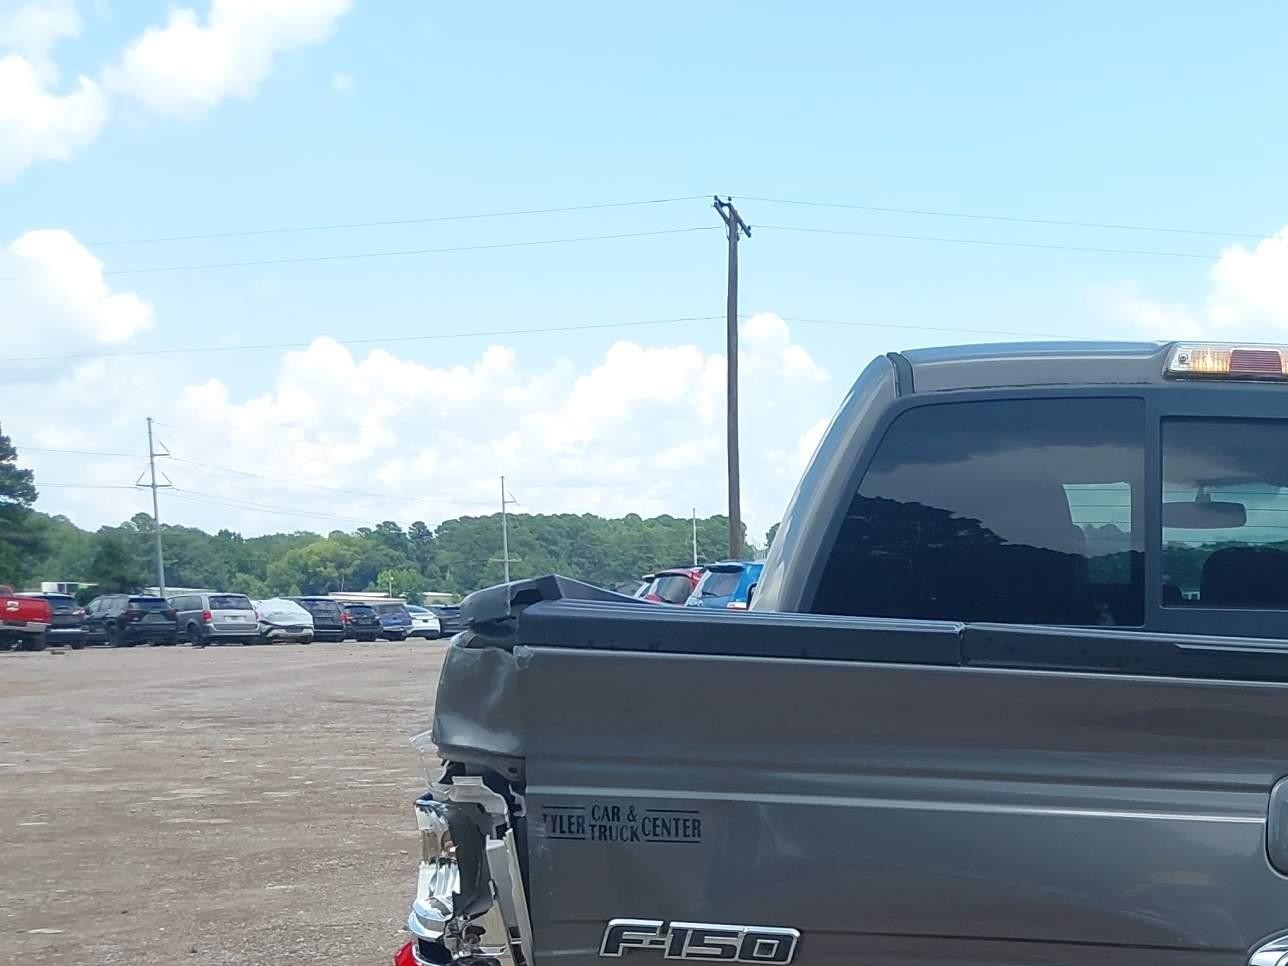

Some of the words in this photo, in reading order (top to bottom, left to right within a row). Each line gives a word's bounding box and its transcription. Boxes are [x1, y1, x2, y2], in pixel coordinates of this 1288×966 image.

[591, 804, 620, 822] CAR
[627, 805, 638, 822] &
[589, 824, 640, 842] TRUCK
[641, 816, 701, 838] CENTER
[599, 918, 800, 965] F-150
